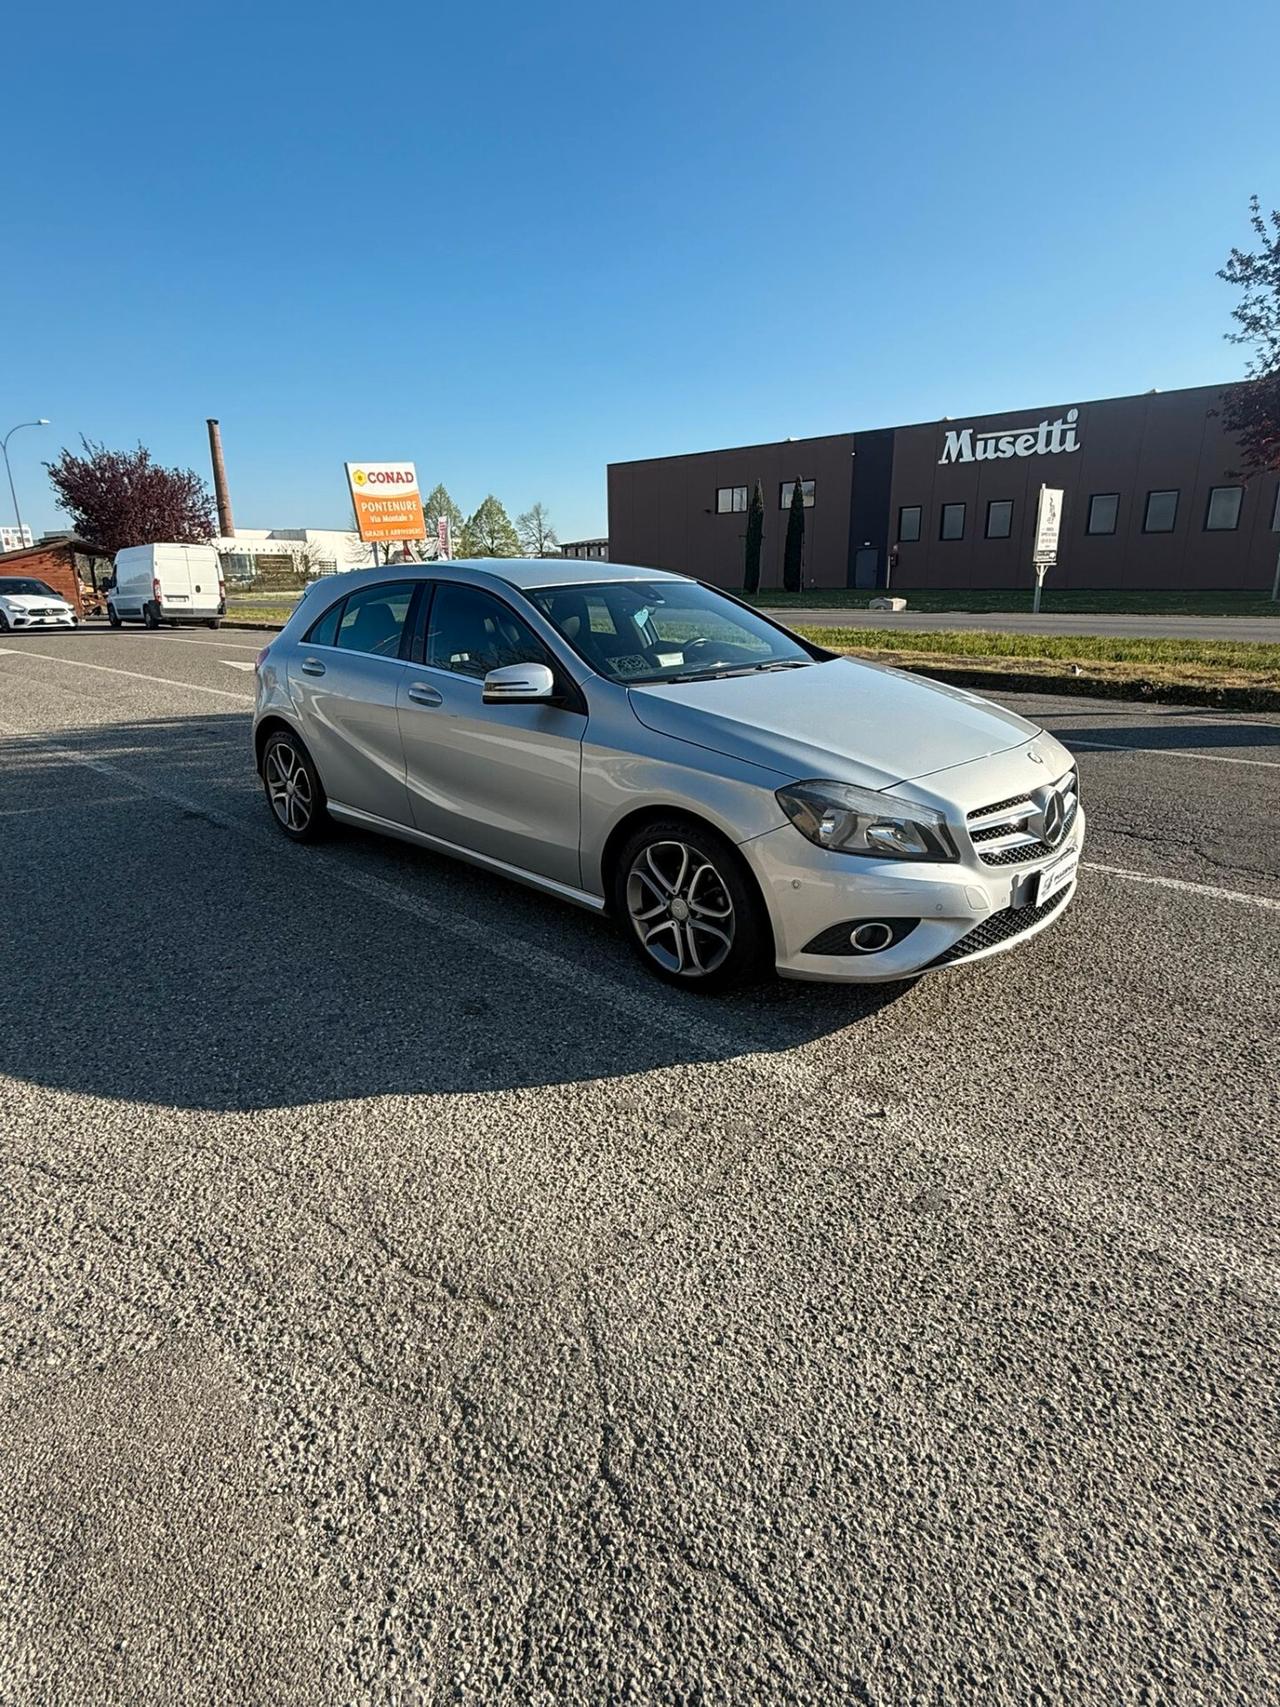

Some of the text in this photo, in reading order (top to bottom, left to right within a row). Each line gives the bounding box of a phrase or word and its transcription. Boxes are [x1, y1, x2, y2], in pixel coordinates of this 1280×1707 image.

[938, 408, 1080, 465] Musetti
[367, 471, 414, 484] CONAD
[361, 501, 417, 512] PONTENURE
[370, 515, 381, 523] Via
